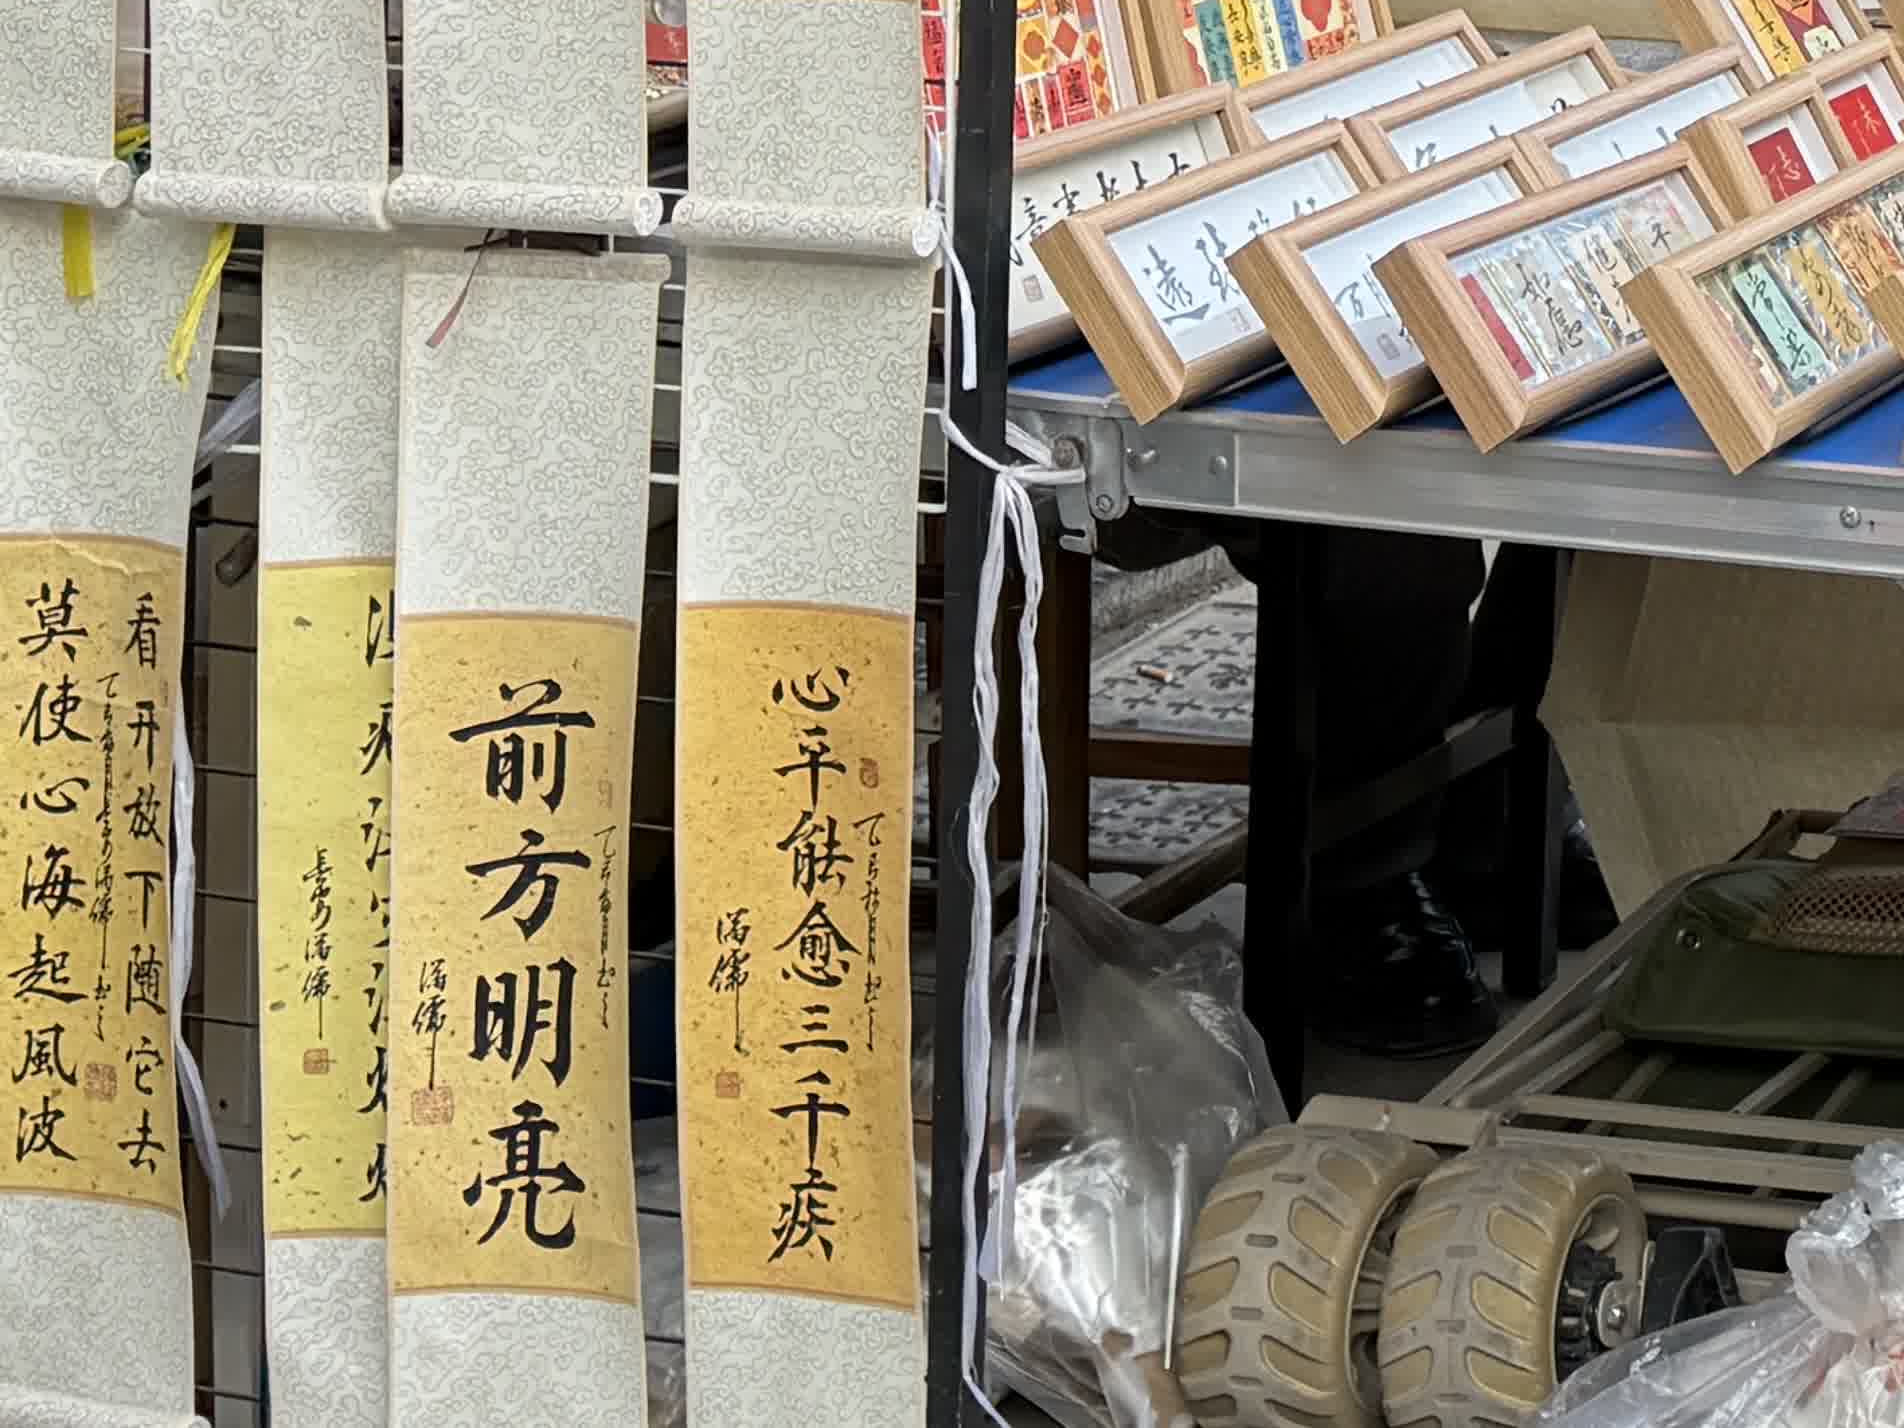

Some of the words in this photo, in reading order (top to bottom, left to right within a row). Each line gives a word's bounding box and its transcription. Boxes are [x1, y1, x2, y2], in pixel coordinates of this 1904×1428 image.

[8, 577, 94, 1164] 莫使心海起風波
[448, 677, 596, 1251] 前方明亮
